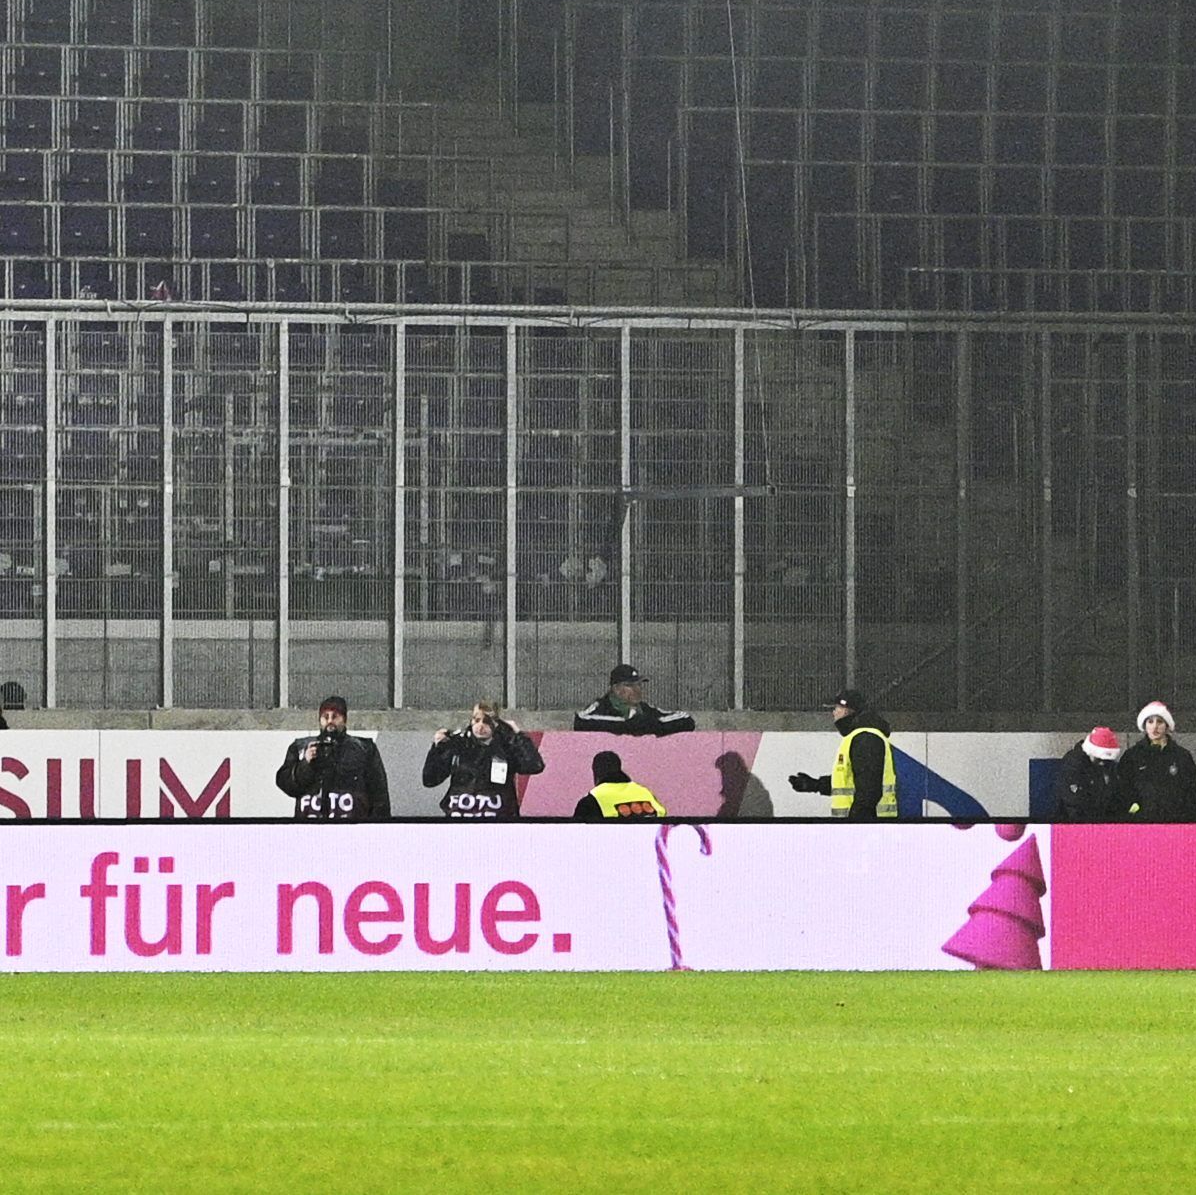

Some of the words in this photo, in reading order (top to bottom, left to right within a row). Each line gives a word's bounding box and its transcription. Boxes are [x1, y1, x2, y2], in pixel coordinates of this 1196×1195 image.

[300, 792, 354, 813] FOTO
[448, 793, 502, 810] FOTO
[81, 851, 235, 957] für
[276, 878, 573, 957] neue.
